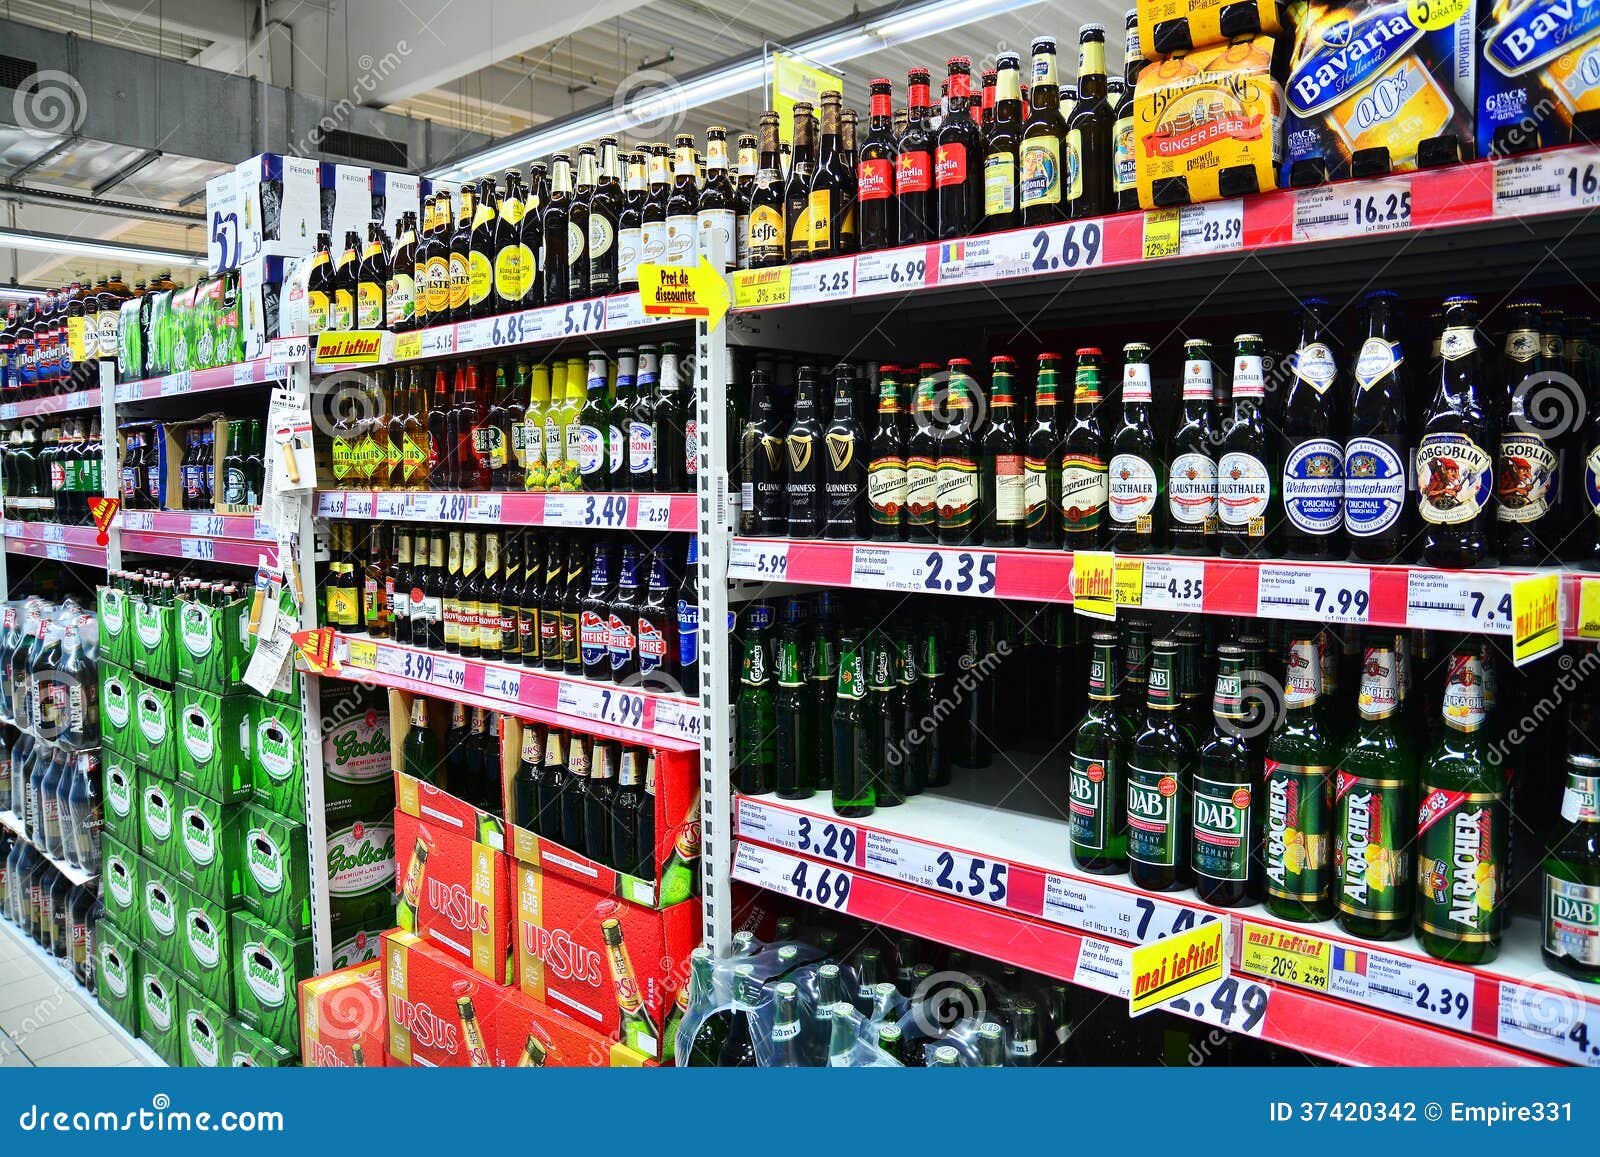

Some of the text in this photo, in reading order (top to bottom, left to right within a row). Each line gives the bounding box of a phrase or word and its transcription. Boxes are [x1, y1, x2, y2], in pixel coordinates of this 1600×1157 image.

[1431, 1, 1464, 21] GRATIS
[1295, 14, 1412, 104] Bavaria
[1458, 28, 1470, 78] IMPORTED
[1496, 88, 1527, 104] PACK
[1159, 119, 1244, 152] GINGER BEER
[1353, 191, 1411, 225] 16.25
[751, 222, 778, 242] Leffe
[1203, 218, 1241, 242] 23.59
[1031, 222, 1101, 271] 2.69
[679, 269, 689, 284] de
[819, 270, 850, 292] 5.25
[890, 259, 926, 283] 6.99
[655, 288, 696, 302] discounter
[564, 300, 604, 334] 5.79
[288, 343, 307, 357] 8.99
[318, 341, 342, 357] mai
[345, 334, 380, 354] ieftin!
[631, 441, 652, 451] RONI
[1417, 445, 1482, 466] HOBGOBLIN
[787, 482, 816, 493] GUINNESS
[826, 482, 857, 493] GUINNESS
[1110, 483, 1153, 494] AUSTHALER
[330, 501, 343, 513] 6.59
[358, 502, 371, 514] 6.49
[390, 502, 404, 516] 6.19
[440, 494, 465, 521] 2.89
[584, 496, 627, 526] 3.49
[650, 507, 668, 522] 2.59
[1302, 500, 1336, 508] ORIGINAL
[1349, 500, 1380, 509] ORIGINAL
[855, 546, 890, 556] Staropramen
[757, 553, 788, 574] 5.99
[924, 551, 996, 594] 2.35
[1262, 569, 1311, 578] Weihenstephaner
[1168, 578, 1202, 600] 4.35
[1409, 580, 1423, 588] Bere
[1313, 587, 1369, 615] 7.99
[1516, 588, 1559, 638] mai ieftin!
[1497, 622, 1510, 630] litru
[303, 631, 319, 655] Nou
[404, 652, 433, 680] 3.99
[749, 645, 764, 682] Carlsberg
[875, 652, 888, 684] Carlsberg
[448, 669, 464, 685] 4.99
[852, 656, 866, 696] Carlsberg
[1149, 672, 1166, 686] DAB
[1216, 678, 1236, 693] DAB
[501, 680, 519, 696] 4.99
[600, 690, 643, 727] 7.99
[1129, 786, 1163, 816] DAB
[740, 808, 750, 816] Bere
[1197, 799, 1237, 829] DAB
[798, 816, 856, 863] 3.29
[867, 833, 892, 845] Albacher
[1266, 774, 1290, 886] ALBACHER
[738, 851, 748, 859] Bere
[867, 841, 880, 850] bere
[1343, 789, 1373, 905] ALBACHER
[335, 865, 385, 882] PREMIUM LAGER
[924, 864, 934, 873] LEI
[936, 851, 1007, 902] 2.55
[1449, 807, 1483, 930] ALBACHER
[791, 861, 850, 909] 4.69
[1047, 885, 1063, 896] Bere
[427, 875, 490, 936] URSUS
[1557, 898, 1598, 923] DAB
[1119, 913, 1131, 922] LEI
[1095, 921, 1108, 932] litru
[1109, 925, 1130, 938] 11.35)
[1083, 948, 1098, 959] bere
[1085, 939, 1110, 953] Tuborg
[1248, 930, 1324, 956] mai ieftin!
[523, 920, 602, 988] URSUS
[1135, 933, 1221, 996] mai ieftin!
[1271, 956, 1298, 981] 20%
[1369, 961, 1382, 971] Bere
[1304, 972, 1326, 987] 2.99
[1169, 977, 1268, 1033] .49
[1416, 983, 1469, 1020] 2.39
[391, 994, 459, 1055] URSUS
